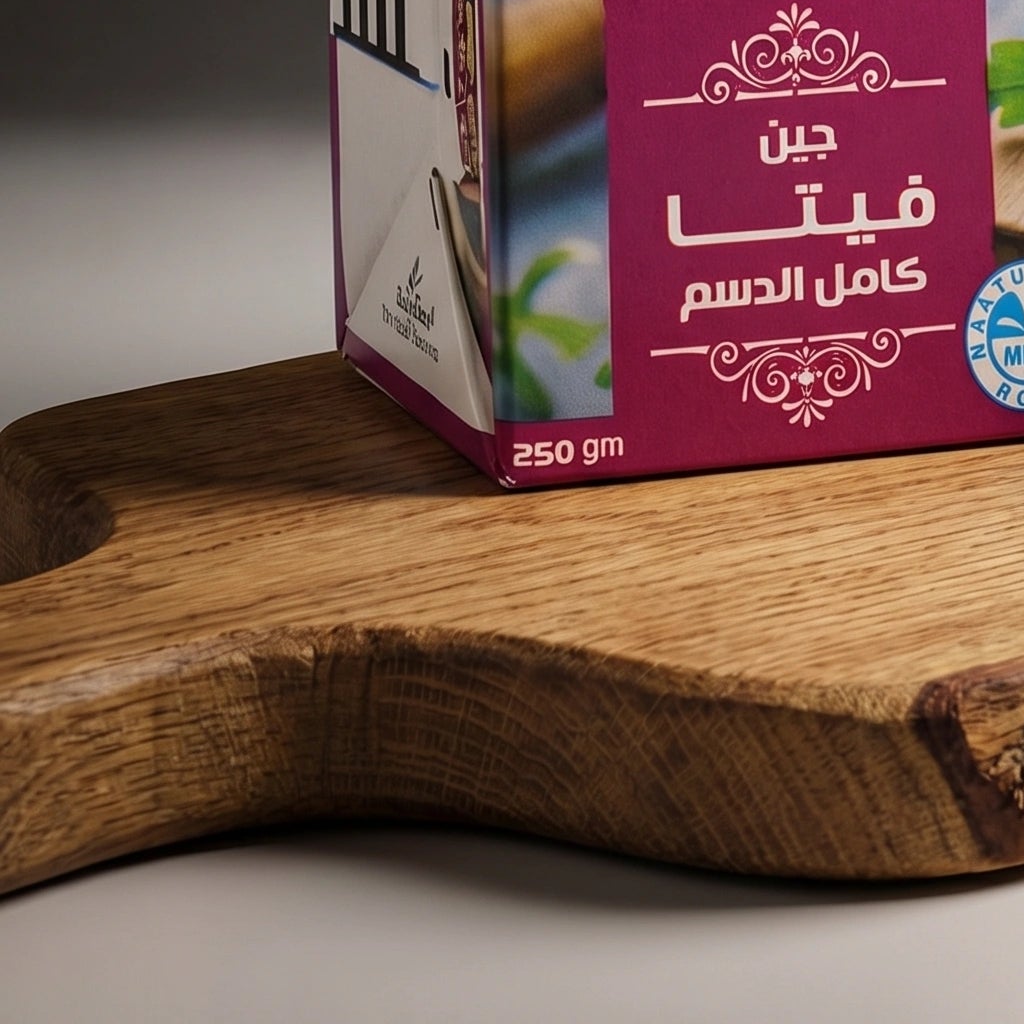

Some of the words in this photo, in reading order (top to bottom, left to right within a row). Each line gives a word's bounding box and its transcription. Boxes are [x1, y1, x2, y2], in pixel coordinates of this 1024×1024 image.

[680, 265, 805, 324] الدسم
[815, 256, 928, 308] كامل
[512, 439, 575, 467] 250
[581, 434, 625, 464] gm
